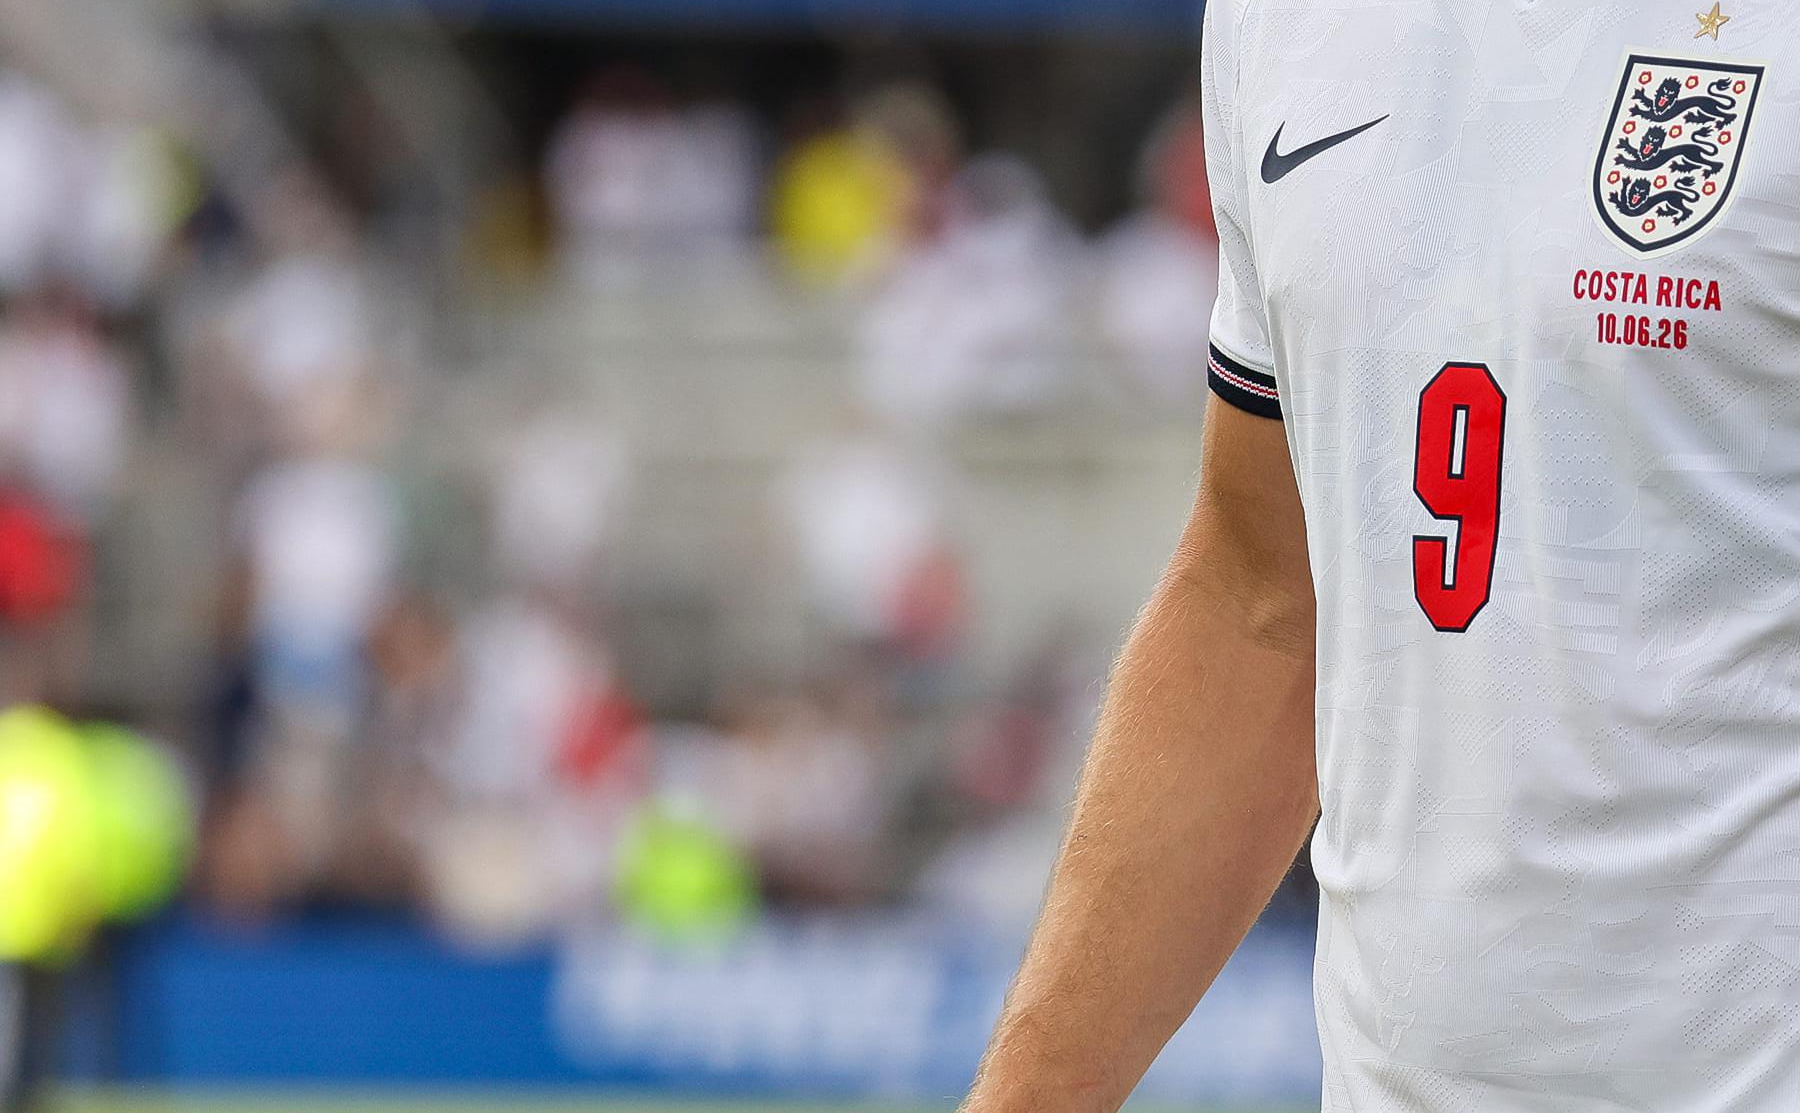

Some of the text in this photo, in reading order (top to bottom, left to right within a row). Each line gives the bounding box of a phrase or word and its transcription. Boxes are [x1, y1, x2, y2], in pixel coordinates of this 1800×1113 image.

[1573, 269, 1722, 311] COSTA RICA
[1597, 313, 1688, 350] 10.06.26
[1412, 361, 1507, 633] 9
